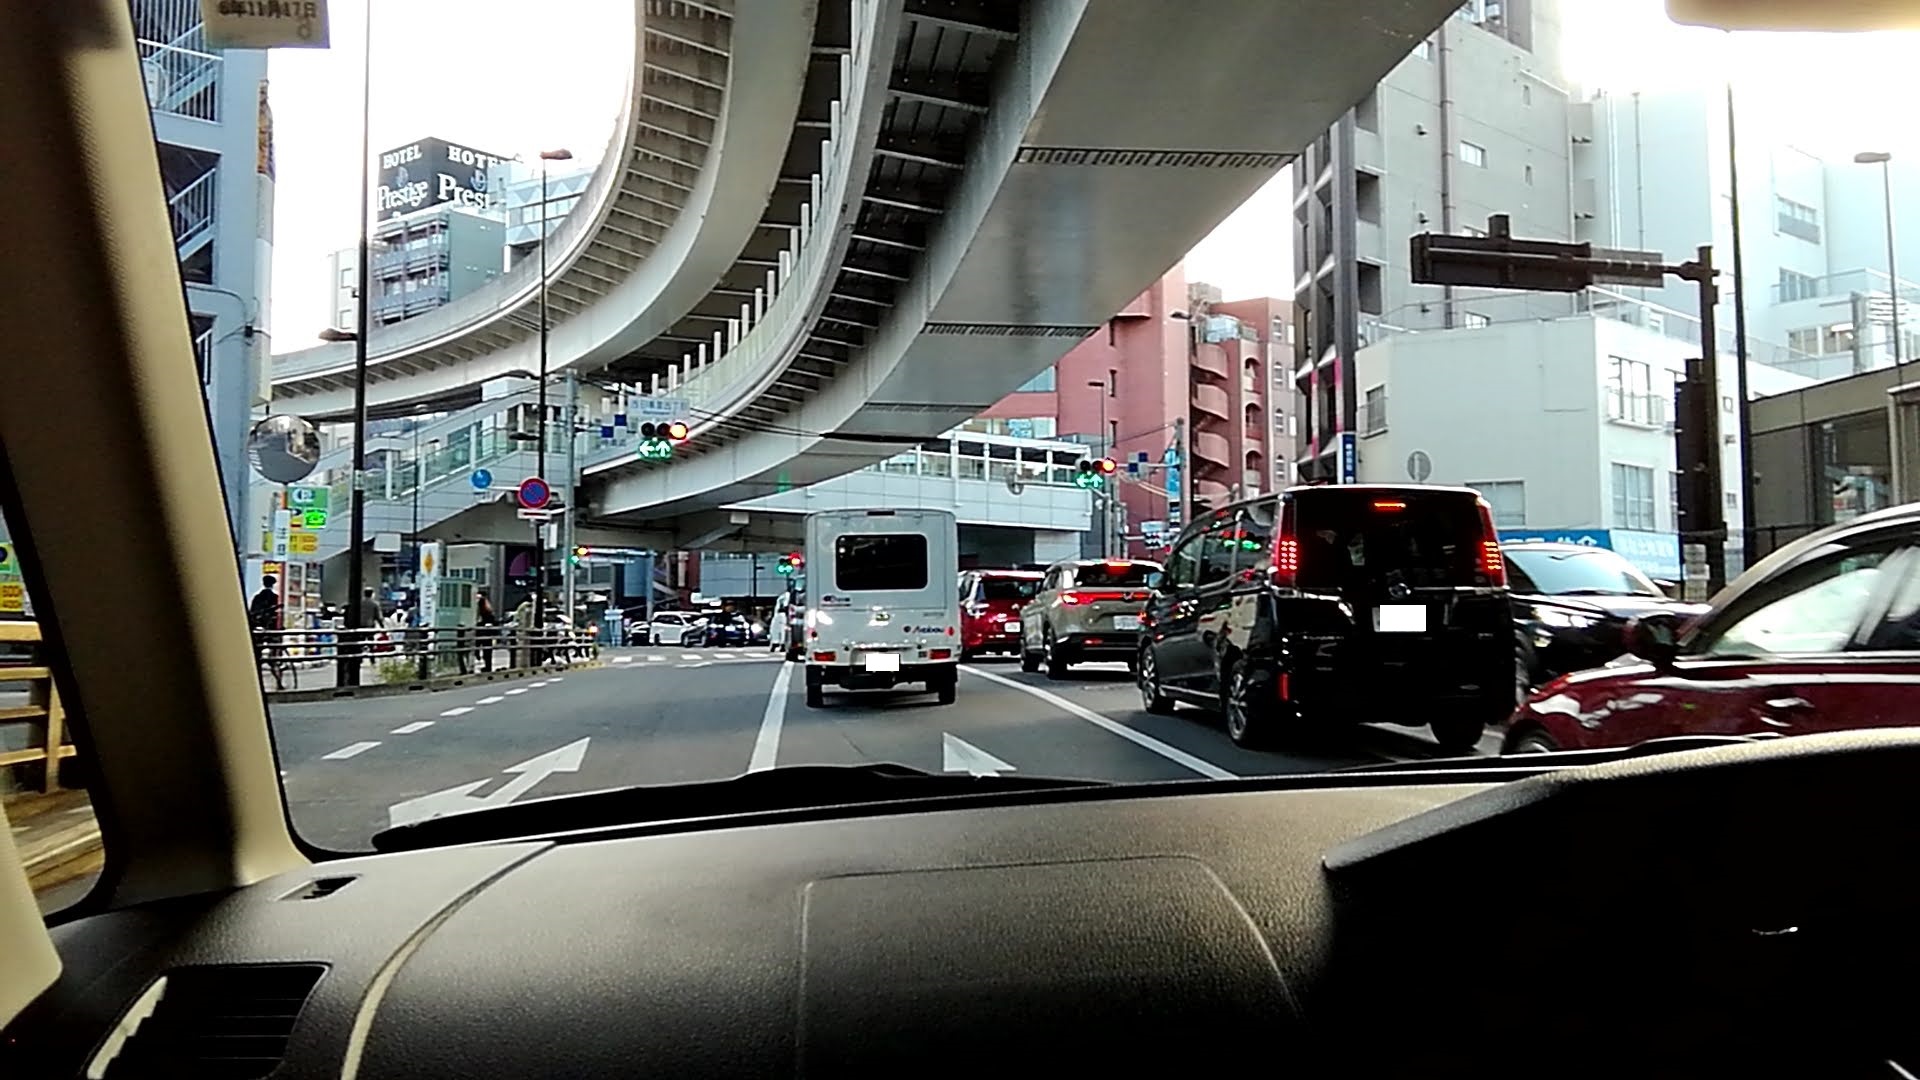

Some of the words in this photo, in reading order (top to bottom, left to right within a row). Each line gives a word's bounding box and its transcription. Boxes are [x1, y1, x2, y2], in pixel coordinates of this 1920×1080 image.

[383, 145, 422, 169] HOTEL
[448, 146, 505, 169] HOTE
[376, 181, 428, 211] Prestige
